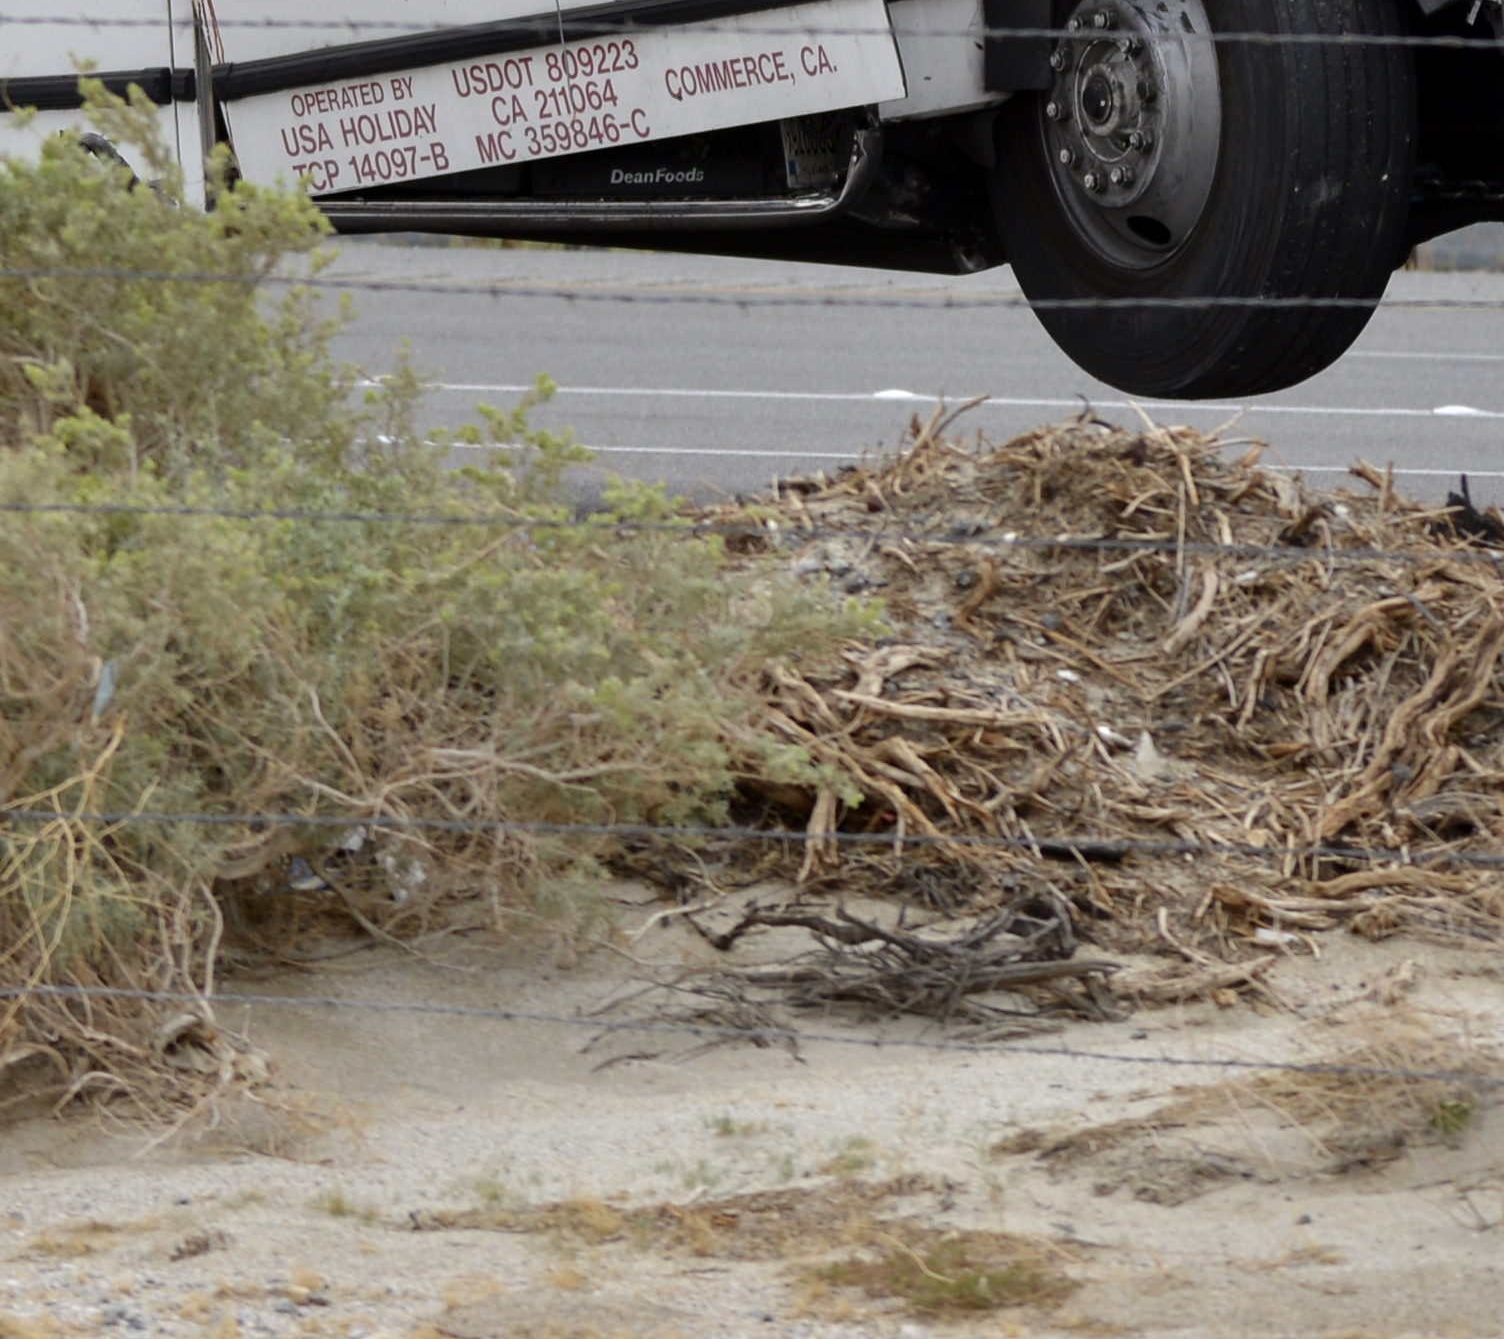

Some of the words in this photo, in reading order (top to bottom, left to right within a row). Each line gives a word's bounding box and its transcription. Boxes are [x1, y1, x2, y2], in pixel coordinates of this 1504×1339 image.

[452, 57, 533, 97] USDOT
[545, 39, 639, 83] 809223
[665, 51, 796, 100] COMMERCE,
[800, 45, 837, 76] CA.
[291, 81, 384, 117] OPERATED
[391, 76, 414, 100] BY
[492, 95, 528, 126] CA
[534, 79, 618, 120] 211064
[281, 123, 333, 157] USA
[340, 104, 436, 146] HOLIDAY
[476, 131, 516, 164] MC
[524, 108, 650, 155] 359846-C
[293, 160, 339, 191] TCP
[349, 142, 449, 184] 14097-B
